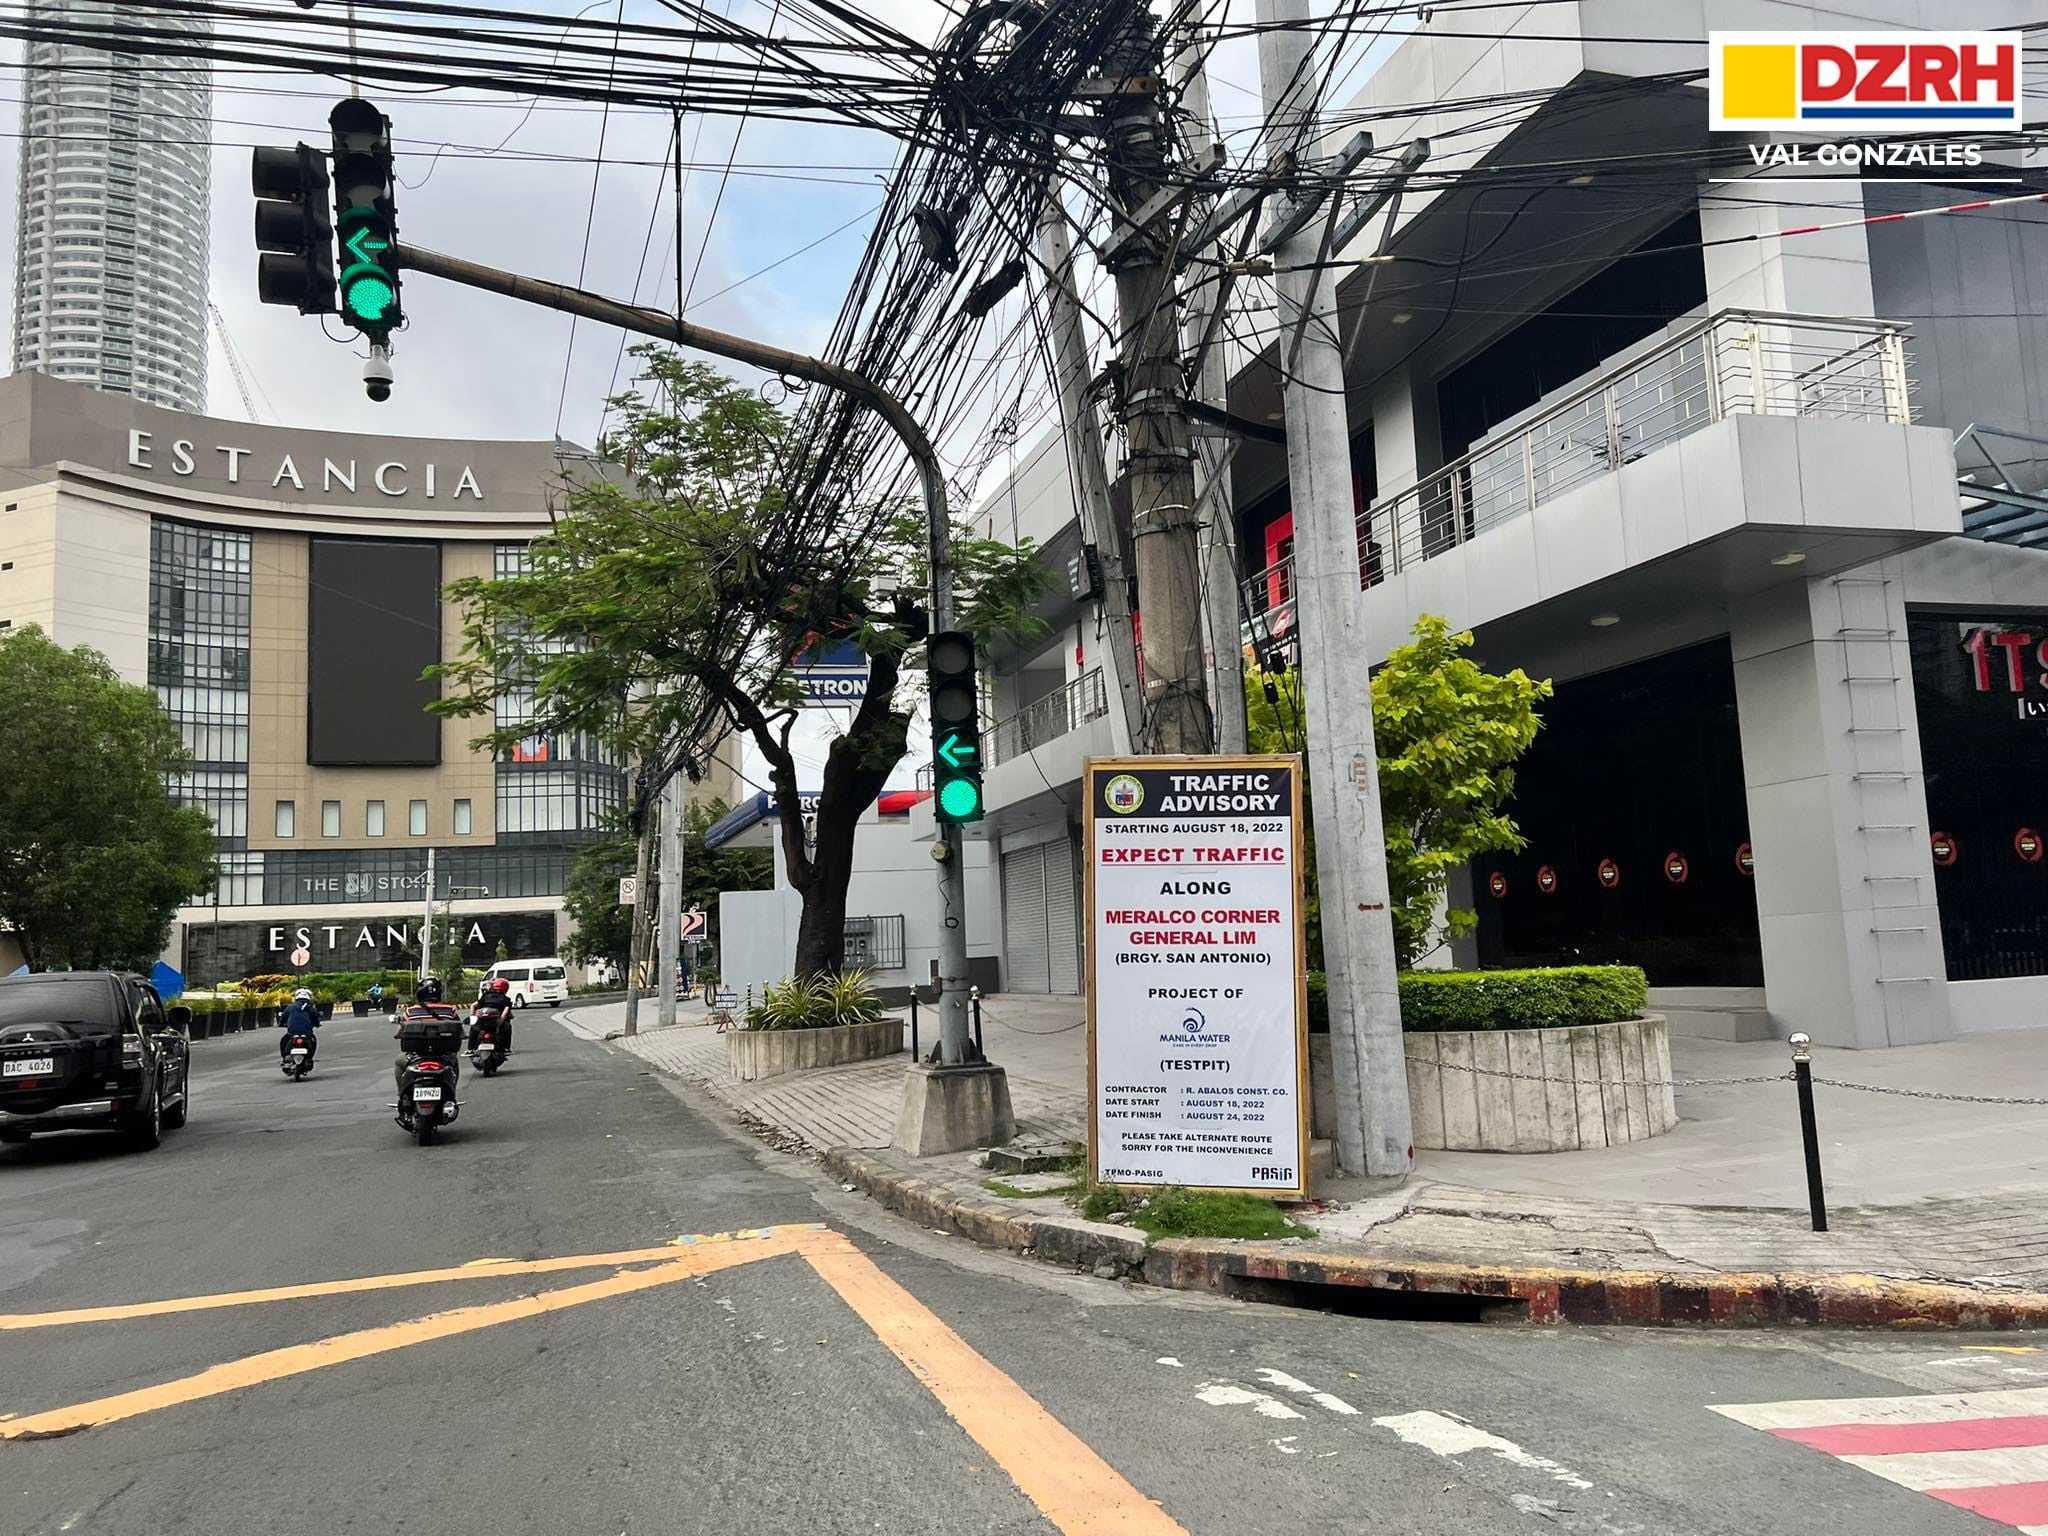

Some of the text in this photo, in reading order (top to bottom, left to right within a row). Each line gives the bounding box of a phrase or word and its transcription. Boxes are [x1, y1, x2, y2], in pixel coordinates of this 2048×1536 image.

[128, 428, 484, 500] ESTANCIA
[1169, 774, 1270, 792] TRAFFIC
[1159, 794, 1281, 812] ADVISORY
[1105, 823, 1284, 835] STARTING AUGUST 18, 2022
[1101, 847, 1285, 863] EXPECT TRAFFIC
[303, 878, 339, 891] THE
[1159, 881, 1232, 895] ALONG
[1105, 909, 1281, 924] MERALCO CORNER
[269, 920, 486, 951] ESTANCIA
[1129, 931, 1256, 945] GENERAL LIM
[1115, 952, 1271, 966] (BRGY. SAN ANTONIO)
[1148, 988, 1244, 999] PROJECT OF
[1159, 1034, 1230, 1043] MANILA WATER
[1160, 1059, 1231, 1073] (TESTPIT)
[1105, 1086, 1167, 1094] CONTRACTOR
[1197, 1087, 1234, 1095] ABALOS
[1236, 1088, 1270, 1096] CONST.
[1272, 1088, 1289, 1096] CO.
[1105, 1098, 1160, 1106] DATE START
[1186, 1100, 1223, 1108] AUGUST
[1242, 1101, 1265, 1109] 2022
[1105, 1111, 1161, 1119] DATE FINISH
[1186, 1112, 1224, 1121] AUGUST
[1226, 1113, 1241, 1122] 24,
[1242, 1113, 1265, 1121] 2022
[1159, 1133, 1183, 1141] TAKE
[1185, 1134, 1238, 1142] ALTERNATE
[1240, 1135, 1272, 1143] ROUTE
[1175, 1145, 1194, 1153] THE
[1196, 1146, 1273, 1155] INCONVENIENCE
[1105, 1168, 1163, 1177] TPMO-PASIG
